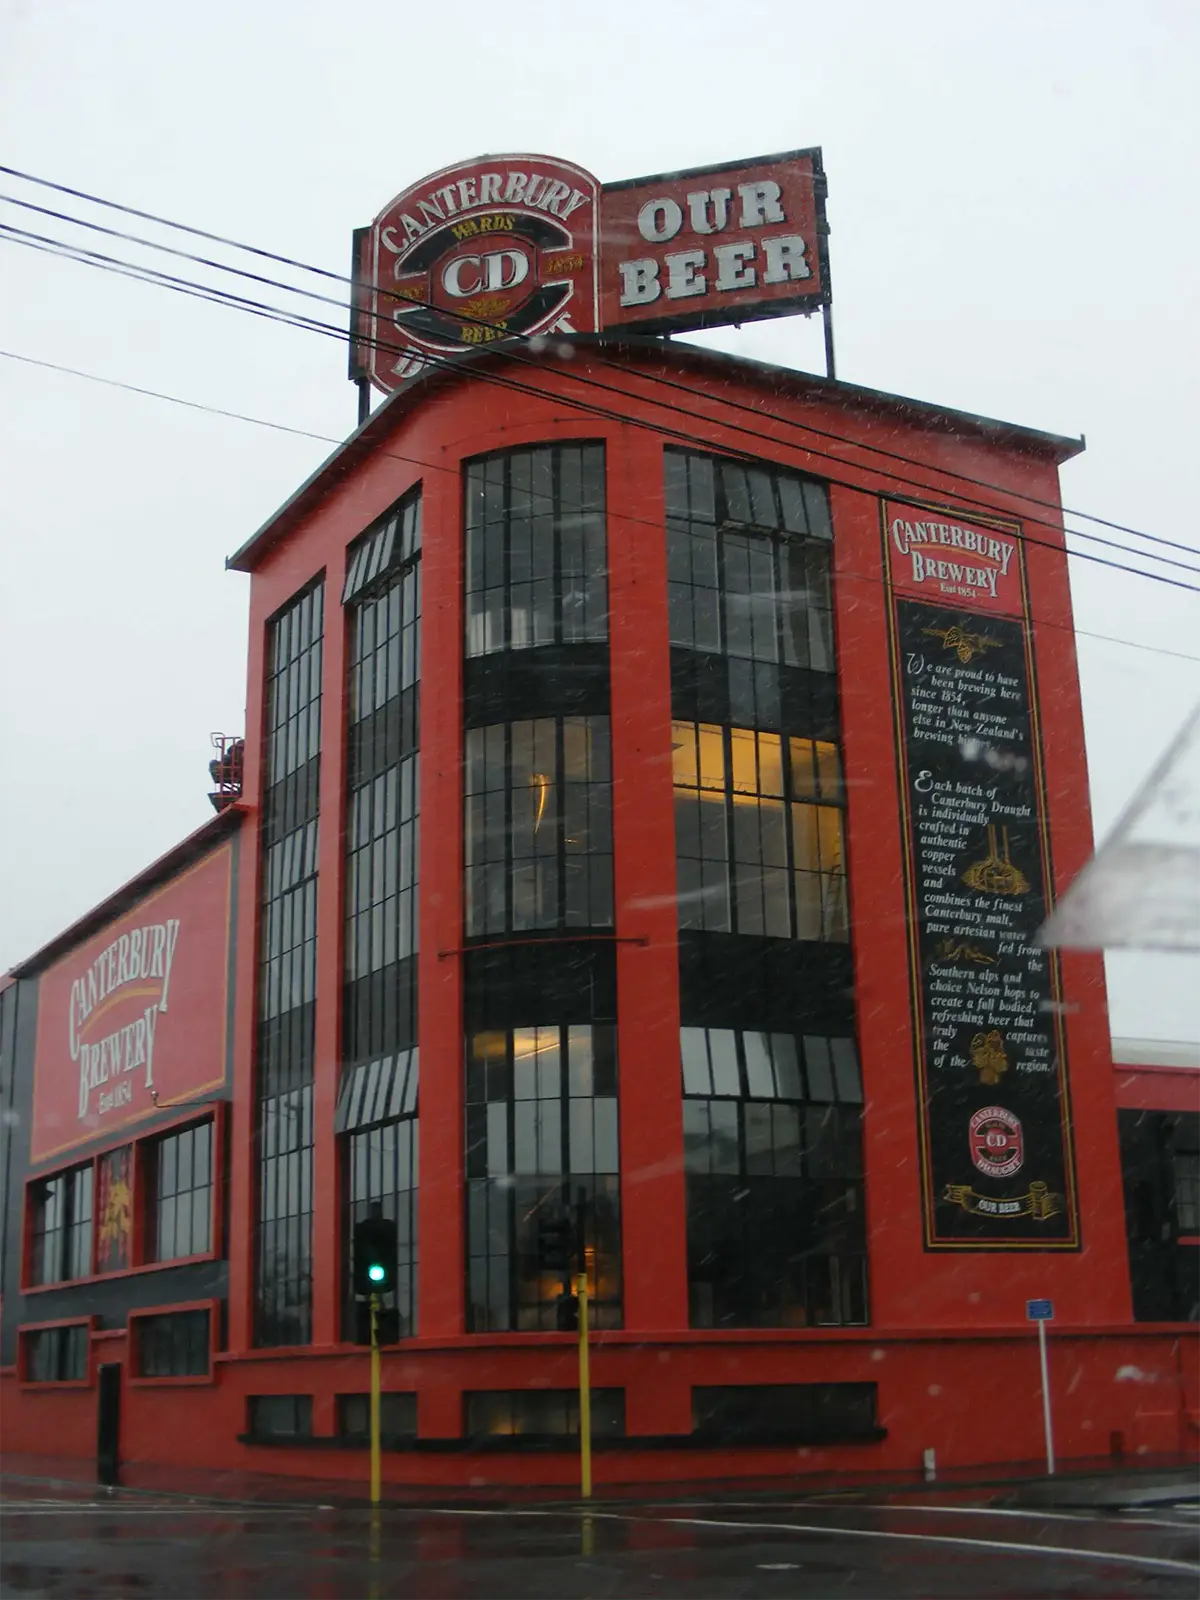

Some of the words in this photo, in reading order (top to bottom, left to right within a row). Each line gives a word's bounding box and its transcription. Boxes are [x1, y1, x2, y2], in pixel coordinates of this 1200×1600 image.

[381, 172, 591, 254] CANTERBURY
[637, 180, 785, 242] OUR
[451, 215, 516, 240] WARDS
[442, 248, 529, 297] CD
[618, 234, 811, 307] BEER
[461, 321, 508, 344] BEER
[893, 518, 1014, 575] CANTERBURY
[911, 550, 998, 597] BREWERY
[906, 653, 933, 674] We
[935, 665, 952, 675] are
[955, 667, 983, 680] proud
[985, 671, 994, 682] to
[997, 674, 1019, 686] have
[910, 686, 937, 699] since
[931, 675, 954, 688] been
[958, 680, 996, 697] brewing
[1000, 687, 1021, 700] here
[912, 699, 943, 714] longer
[947, 704, 969, 718] than
[973, 711, 1007, 725] anyone
[913, 713, 932, 726] else
[935, 716, 946, 728] in
[950, 719, 971, 732] New
[976, 722, 1024, 741] Zealand's
[913, 727, 954, 745] brewing
[914, 770, 952, 793] Each
[955, 782, 983, 797] batch
[986, 787, 997, 800] of
[931, 792, 987, 812] Canterbury
[991, 801, 1031, 817] Draught
[918, 804, 928, 816] is
[932, 806, 990, 826] individually
[919, 820, 956, 834] crafted
[959, 823, 970, 835] in
[920, 835, 968, 849] authentic
[921, 849, 956, 863] copper
[922, 864, 957, 876] vessels
[923, 878, 943, 888] and
[924, 893, 971, 906] combines
[975, 896, 990, 909] the
[993, 898, 1023, 913] finest
[925, 905, 982, 924] Canterbury
[926, 922, 949, 934] pure
[953, 926, 996, 939] artesian
[999, 930, 1026, 941] water
[997, 942, 1014, 954] fed
[1017, 942, 1042, 957] from
[929, 963, 975, 980] Southern
[978, 969, 999, 983] alps
[1003, 972, 1022, 983] and
[1027, 959, 1043, 972] the
[69, 919, 180, 1061] CANTERBURY
[930, 979, 963, 992] choice
[966, 982, 1000, 995] Nelson
[1004, 985, 1026, 1000] hops
[1029, 989, 1040, 1000] to
[931, 997, 963, 1008] create
[967, 1000, 974, 1009] a
[977, 998, 995, 1012] full
[999, 1000, 1037, 1014] bodied,
[932, 1010, 984, 1026] refreshing
[988, 1013, 1010, 1025] beer
[1014, 1015, 1034, 1028] that
[932, 1025, 957, 1038] truly
[1006, 1031, 1048, 1043] captures
[933, 1039, 949, 1051] the
[78, 1004, 158, 1119] BREWERY
[934, 1054, 945, 1068] of
[950, 1055, 966, 1067] the
[1016, 1059, 1050, 1073] region.
[986, 1132, 1007, 1147] CD
[979, 1199, 997, 1213] OUR
[998, 1202, 1020, 1213] BEER
